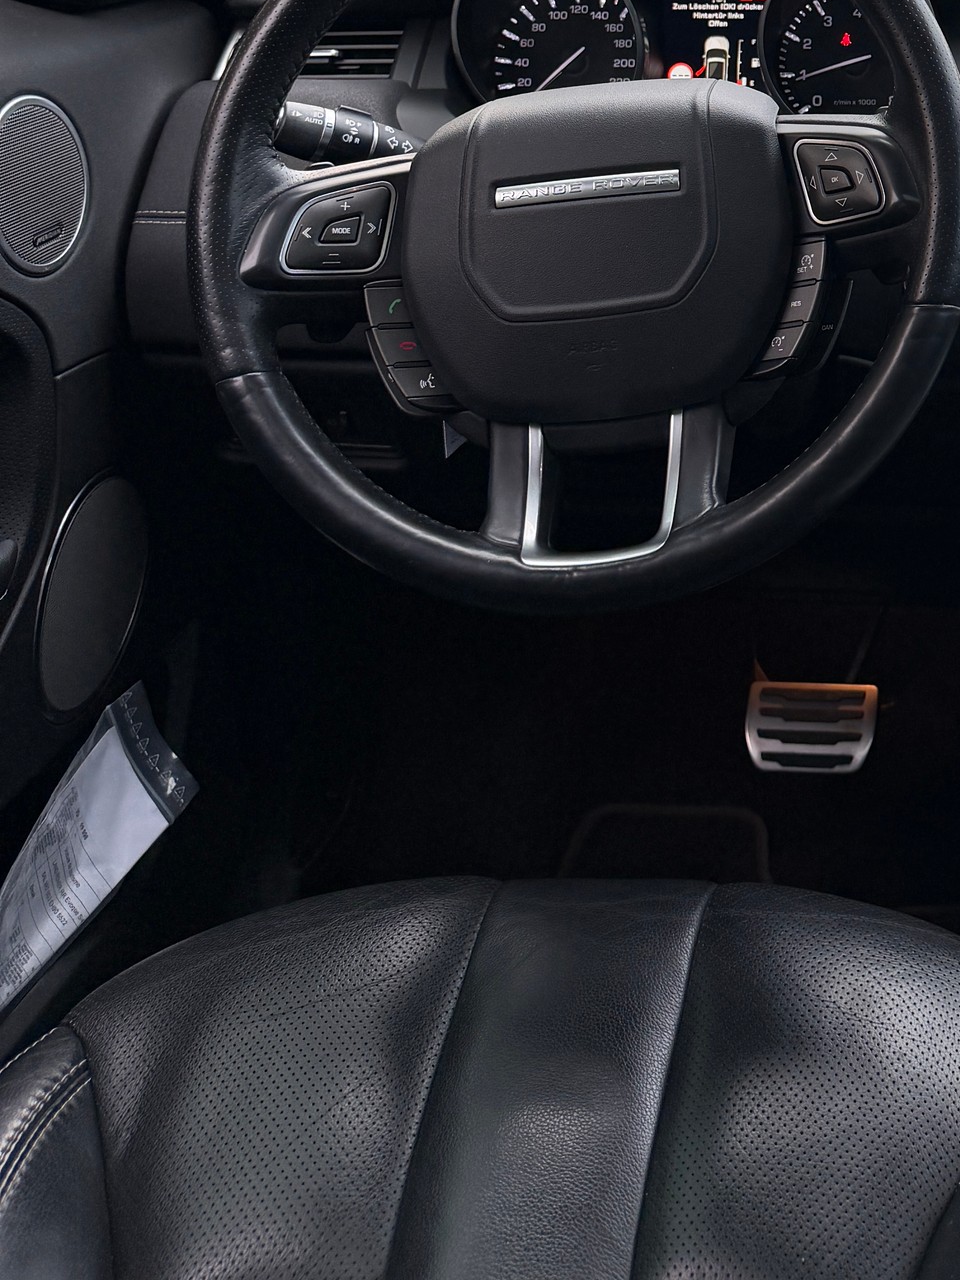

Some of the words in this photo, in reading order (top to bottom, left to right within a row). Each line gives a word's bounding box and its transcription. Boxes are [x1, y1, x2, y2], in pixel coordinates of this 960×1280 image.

[569, 5, 589, 14] 120
[689, 2, 719, 10] Löschen
[548, 11, 568, 20] 100
[590, 11, 609, 20] 140
[853, 9, 862, 18] 4
[823, 16, 833, 27] 3
[531, 23, 546, 32] 80
[605, 23, 624, 32] 160
[520, 38, 534, 48] 60
[614, 39, 632, 48] 180
[803, 38, 812, 49] 2
[514, 58, 529, 67] 40
[613, 59, 635, 68] 200
[517, 78, 531, 87] 20
[812, 95, 822, 106] 0
[305, 117, 323, 125] AUTO
[500, 183, 582, 202] RANGE
[592, 174, 675, 191] ROVER
